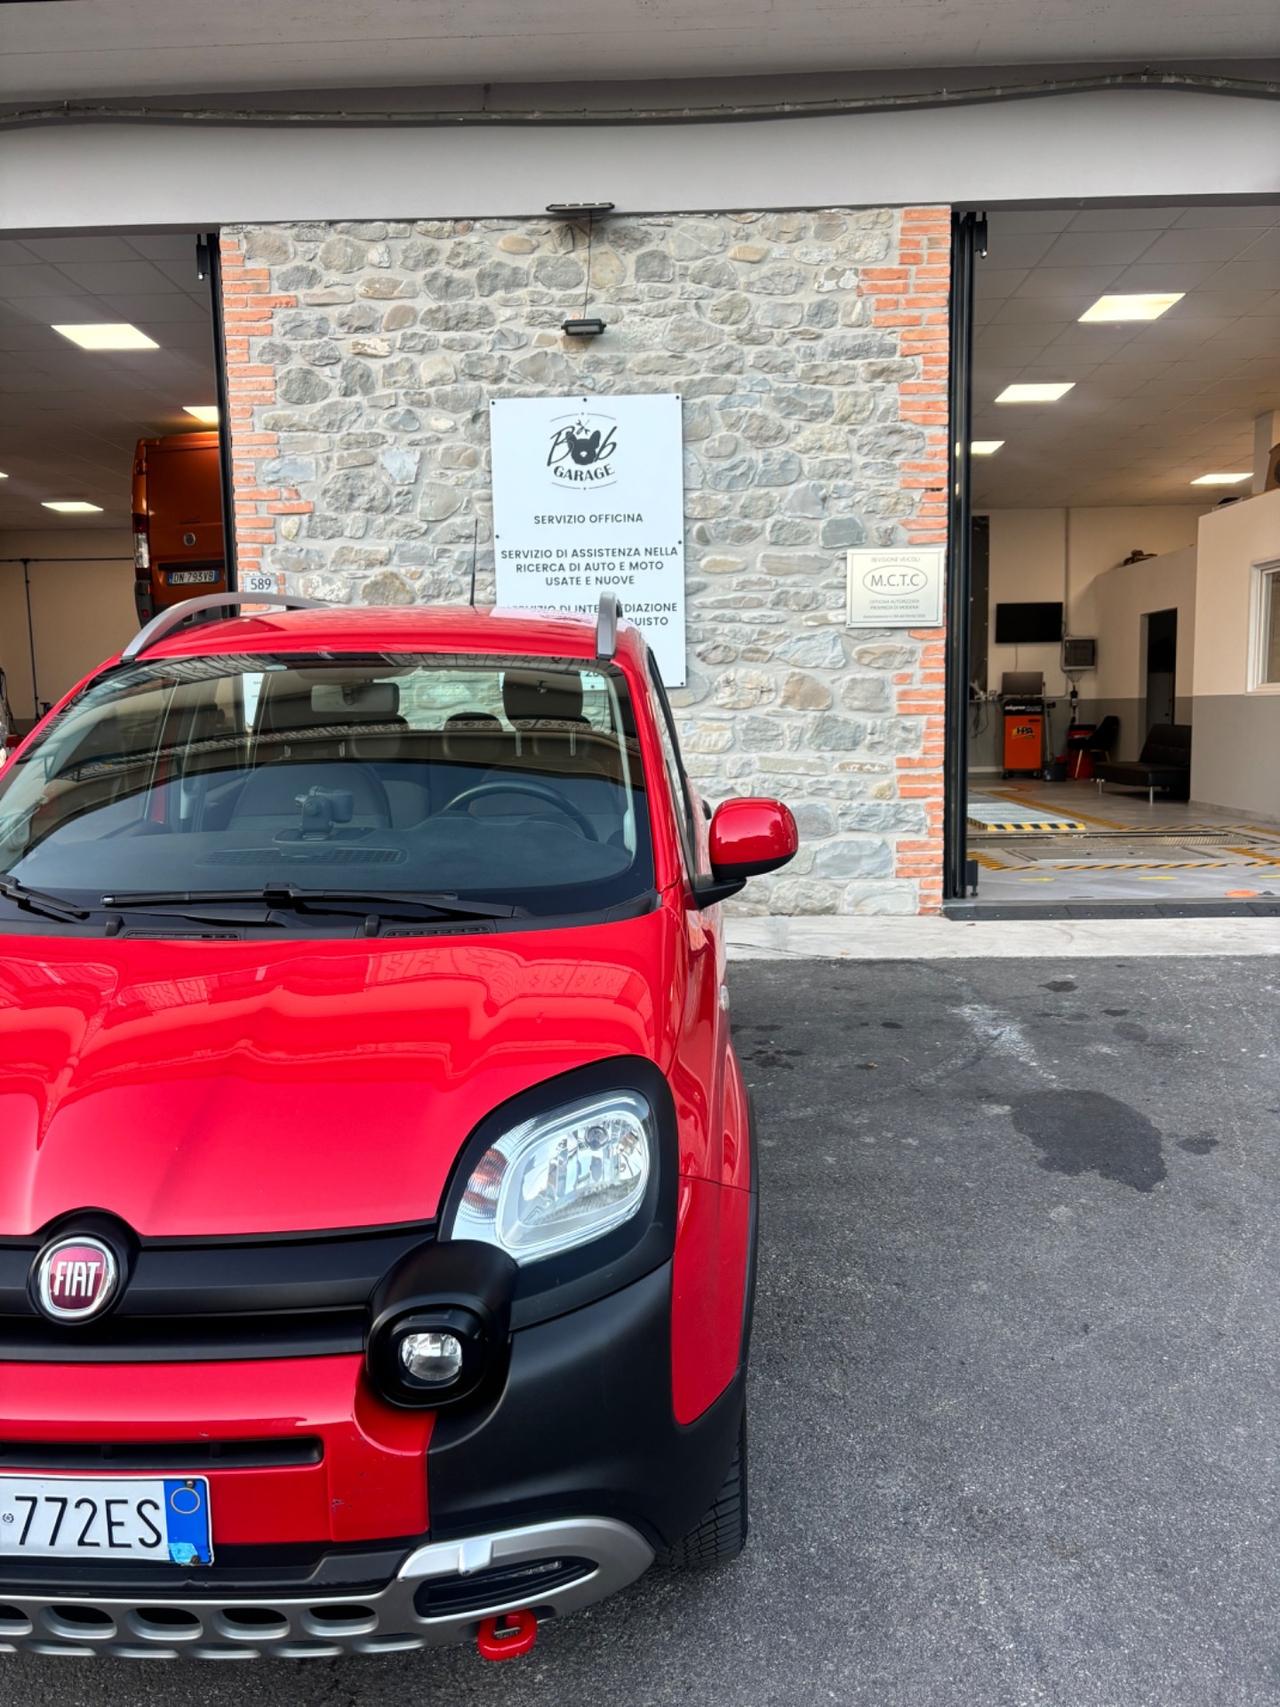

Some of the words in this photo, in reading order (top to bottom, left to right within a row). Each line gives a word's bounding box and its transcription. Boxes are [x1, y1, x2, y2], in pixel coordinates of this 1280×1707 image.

[553, 463, 616, 482] GARAGE
[533, 514, 586, 525] SERVIZIO
[588, 513, 644, 524] OFFICINA
[500, 549, 553, 560] SERVIZIO
[556, 549, 568, 559] DI
[571, 547, 641, 558] ASSISTENZA
[644, 546, 679, 557] NELLA
[515, 562, 566, 573] RICERCA
[569, 562, 581, 572] DI
[584, 561, 616, 572] AUTO
[619, 561, 626, 571] E
[628, 560, 665, 571] MOTO
[250, 578, 273, 591] 589
[545, 576, 582, 587] USATE
[585, 576, 592, 586] E
[594, 575, 636, 586] NUOVE
[53, 1260, 101, 1297] FIAT
[14, 1495, 163, 1549] 772ES
